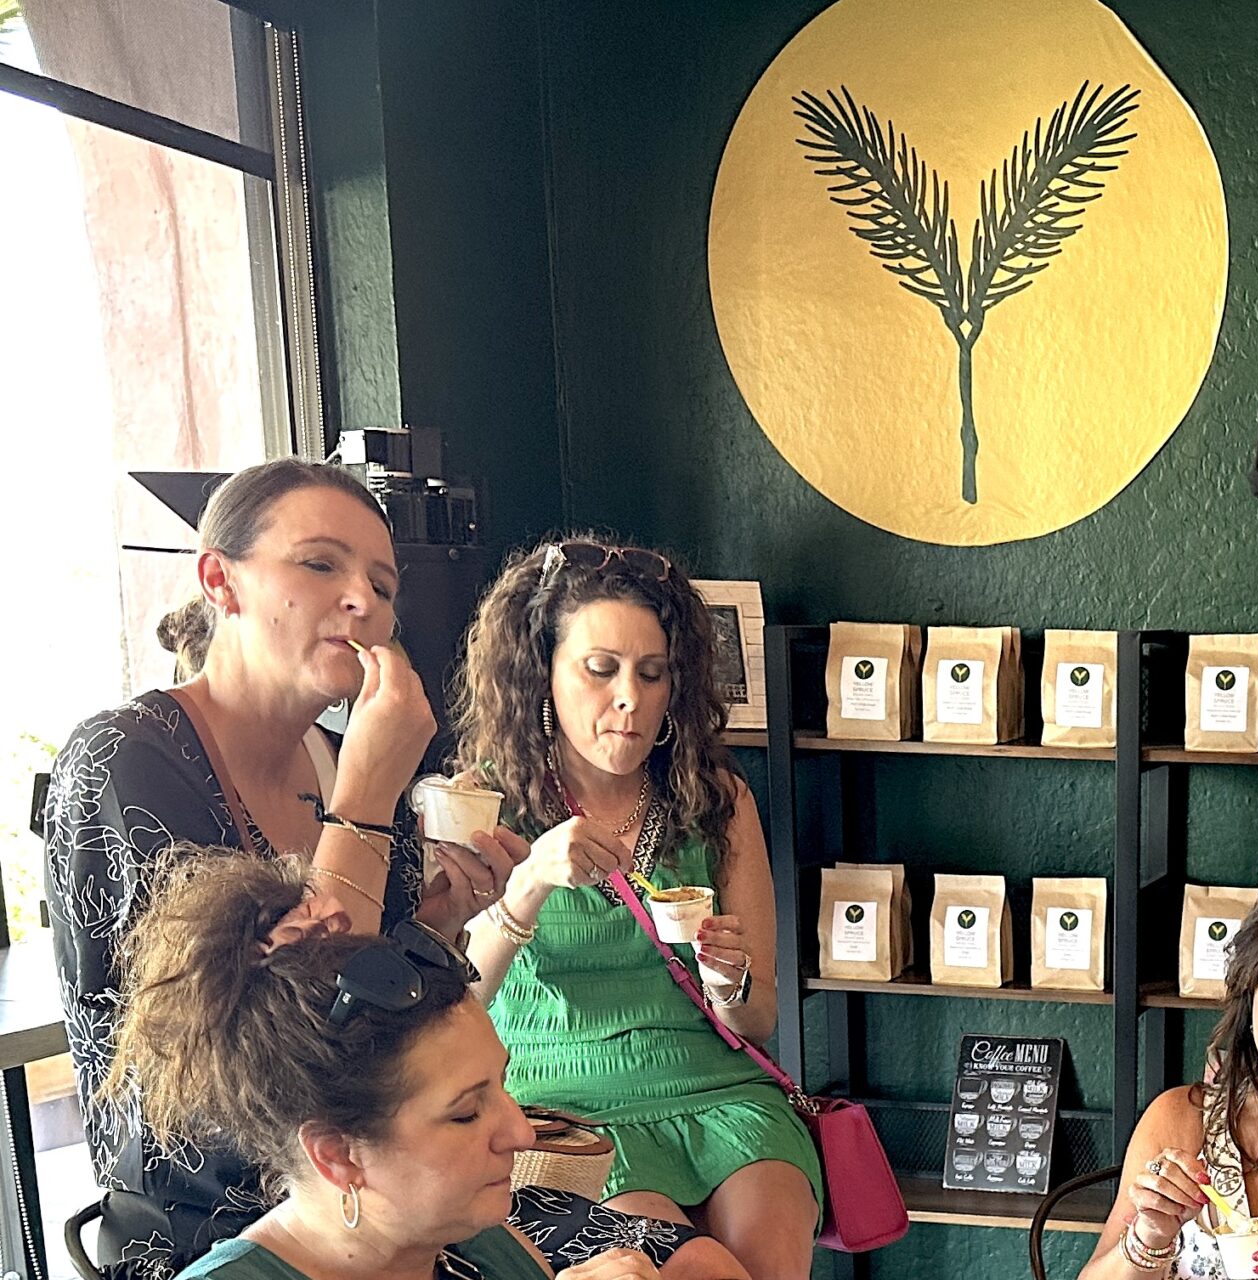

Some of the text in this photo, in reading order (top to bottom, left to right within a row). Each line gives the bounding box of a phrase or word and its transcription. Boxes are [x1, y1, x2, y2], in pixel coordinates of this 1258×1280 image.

[971, 1040, 1048, 1068] Coffee MENU
[1015, 1065, 1042, 1073] COFFEE
